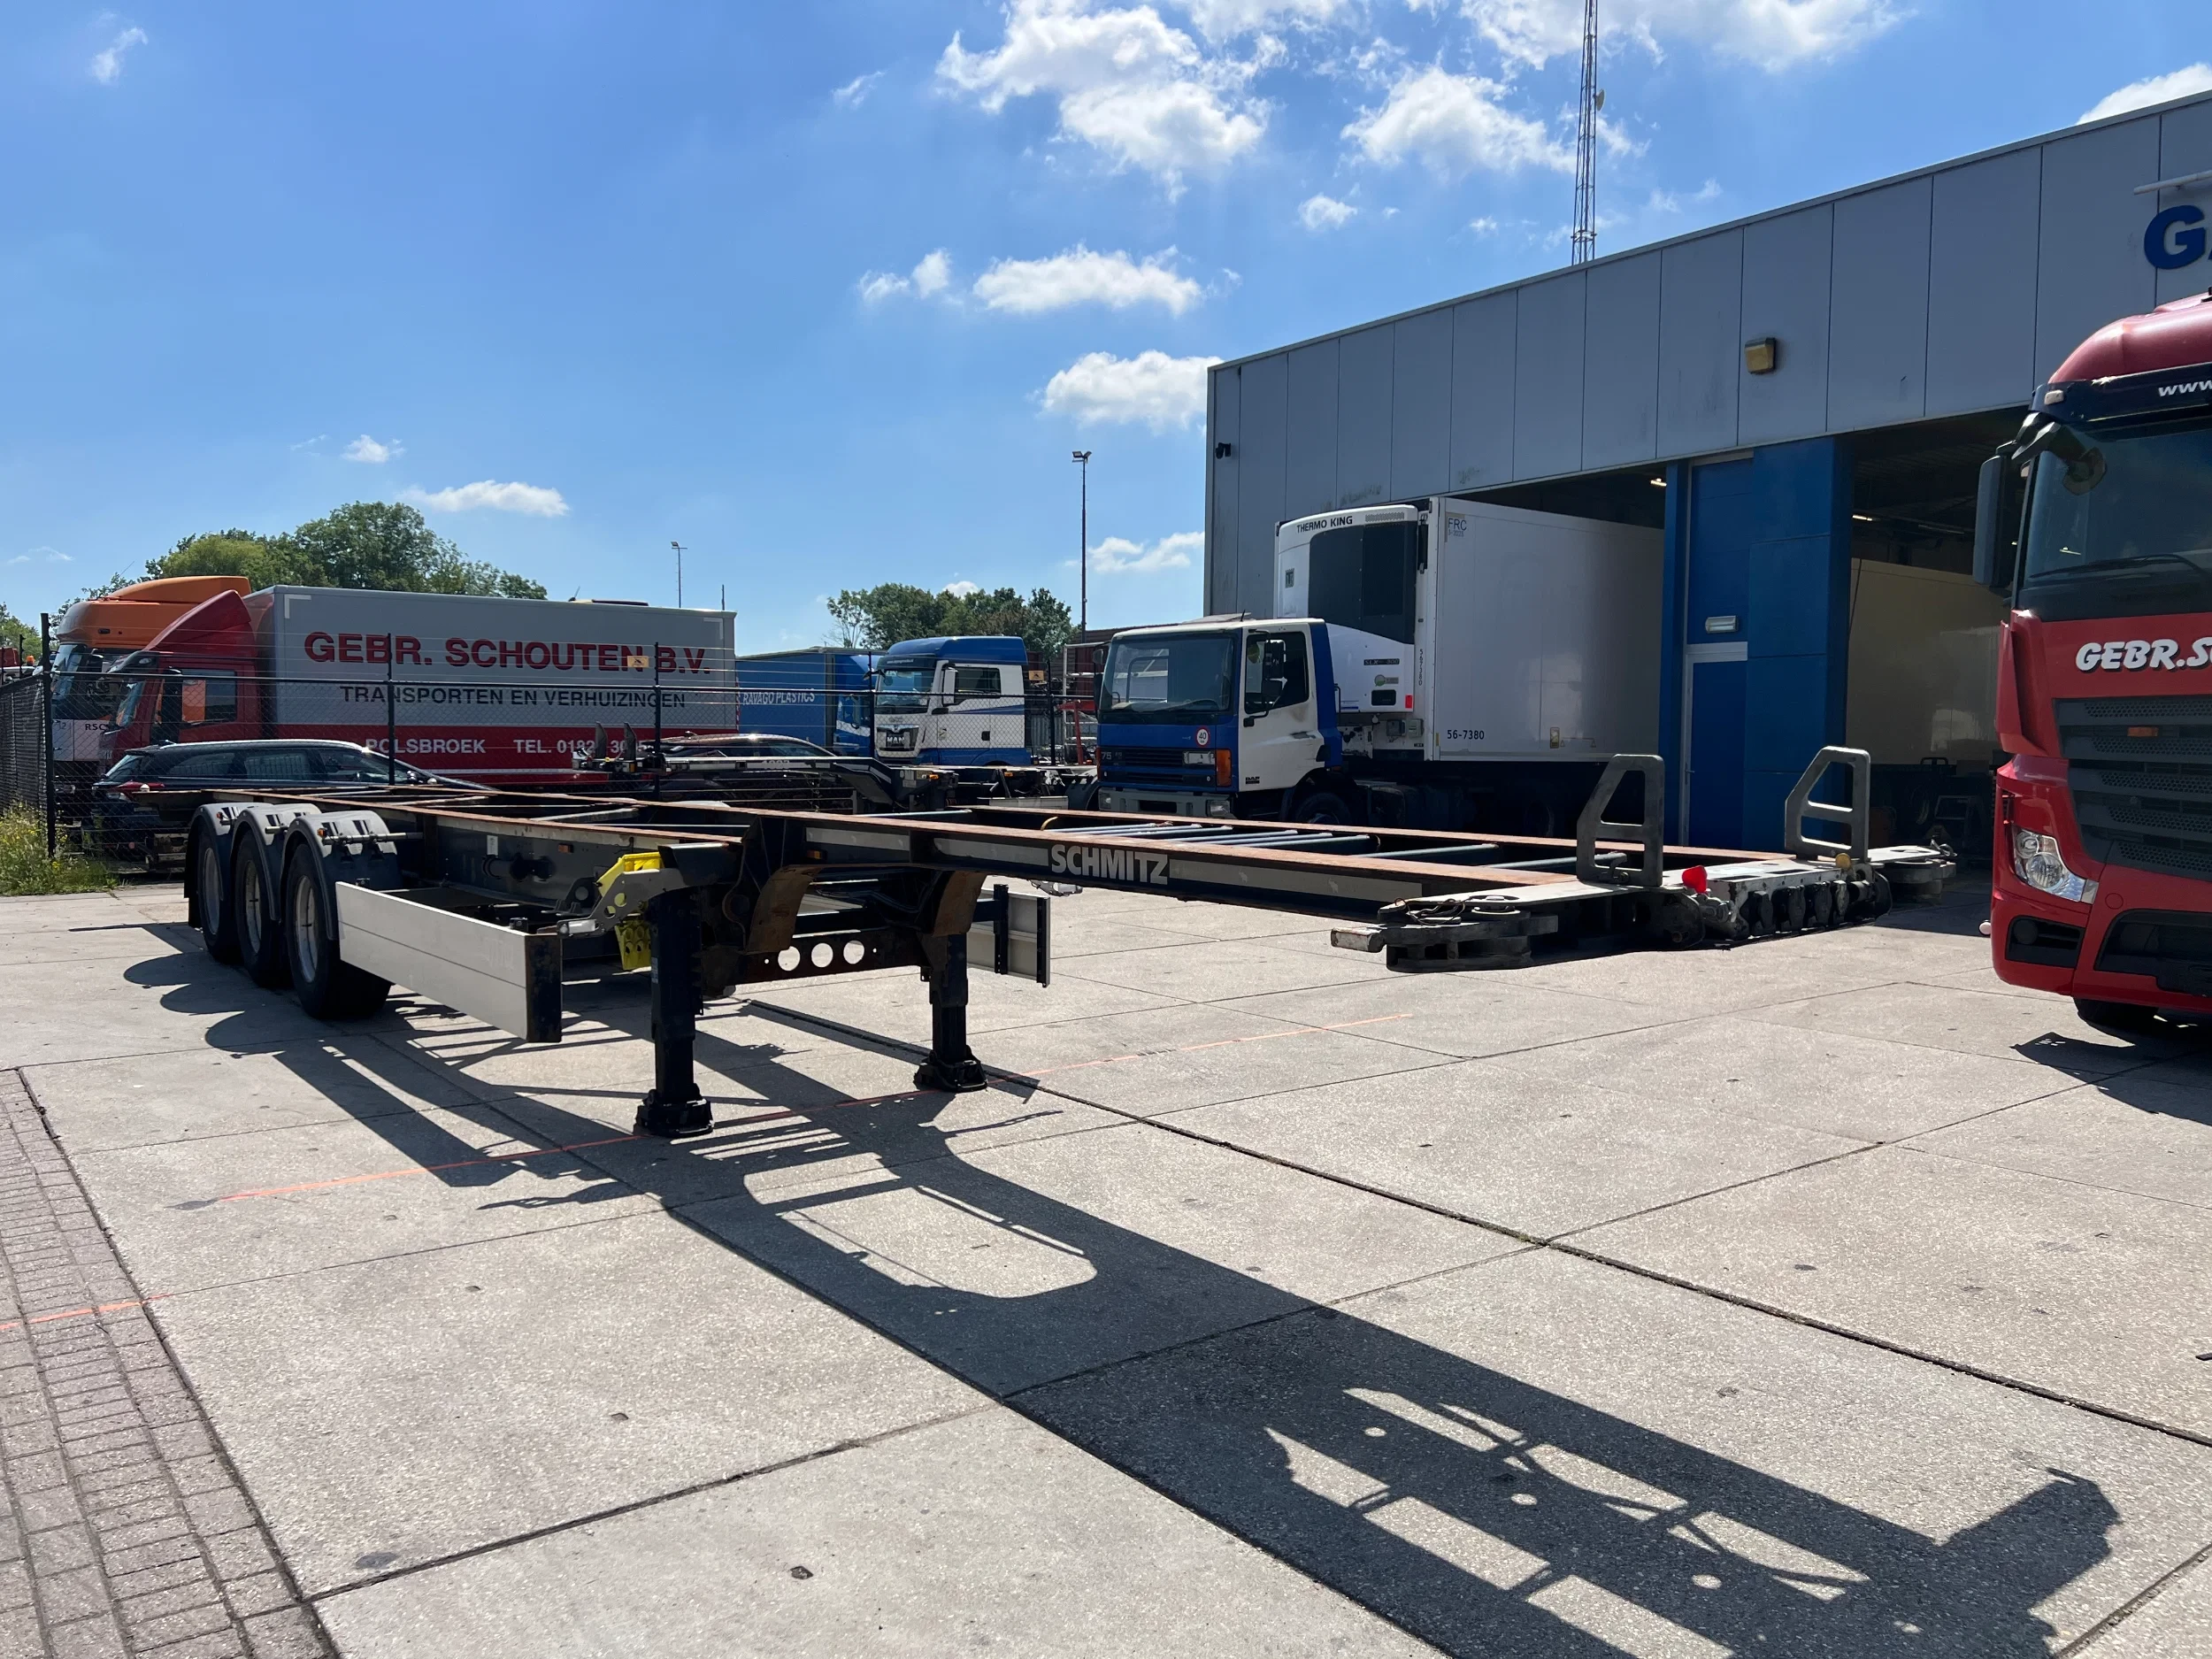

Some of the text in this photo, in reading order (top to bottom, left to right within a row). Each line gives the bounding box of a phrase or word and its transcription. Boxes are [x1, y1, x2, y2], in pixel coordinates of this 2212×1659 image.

[2144, 204, 2212, 269] G
[1296, 516, 1353, 534] THERMO KING
[1448, 518, 1467, 531] FRC
[303, 631, 710, 674] GEBR. SCHOUTEN B.V.
[2076, 636, 2212, 673] GEBR.S
[340, 686, 686, 709] TRANSPORTEN EN VERHUIZINGEN
[742, 692, 815, 705] RAVAGO PLASTICS
[1447, 729, 1485, 741] 56-7380
[513, 740, 552, 754] TEL.
[1101, 751, 1112, 760] 75
[1050, 844, 1169, 885] SCHMITZ
